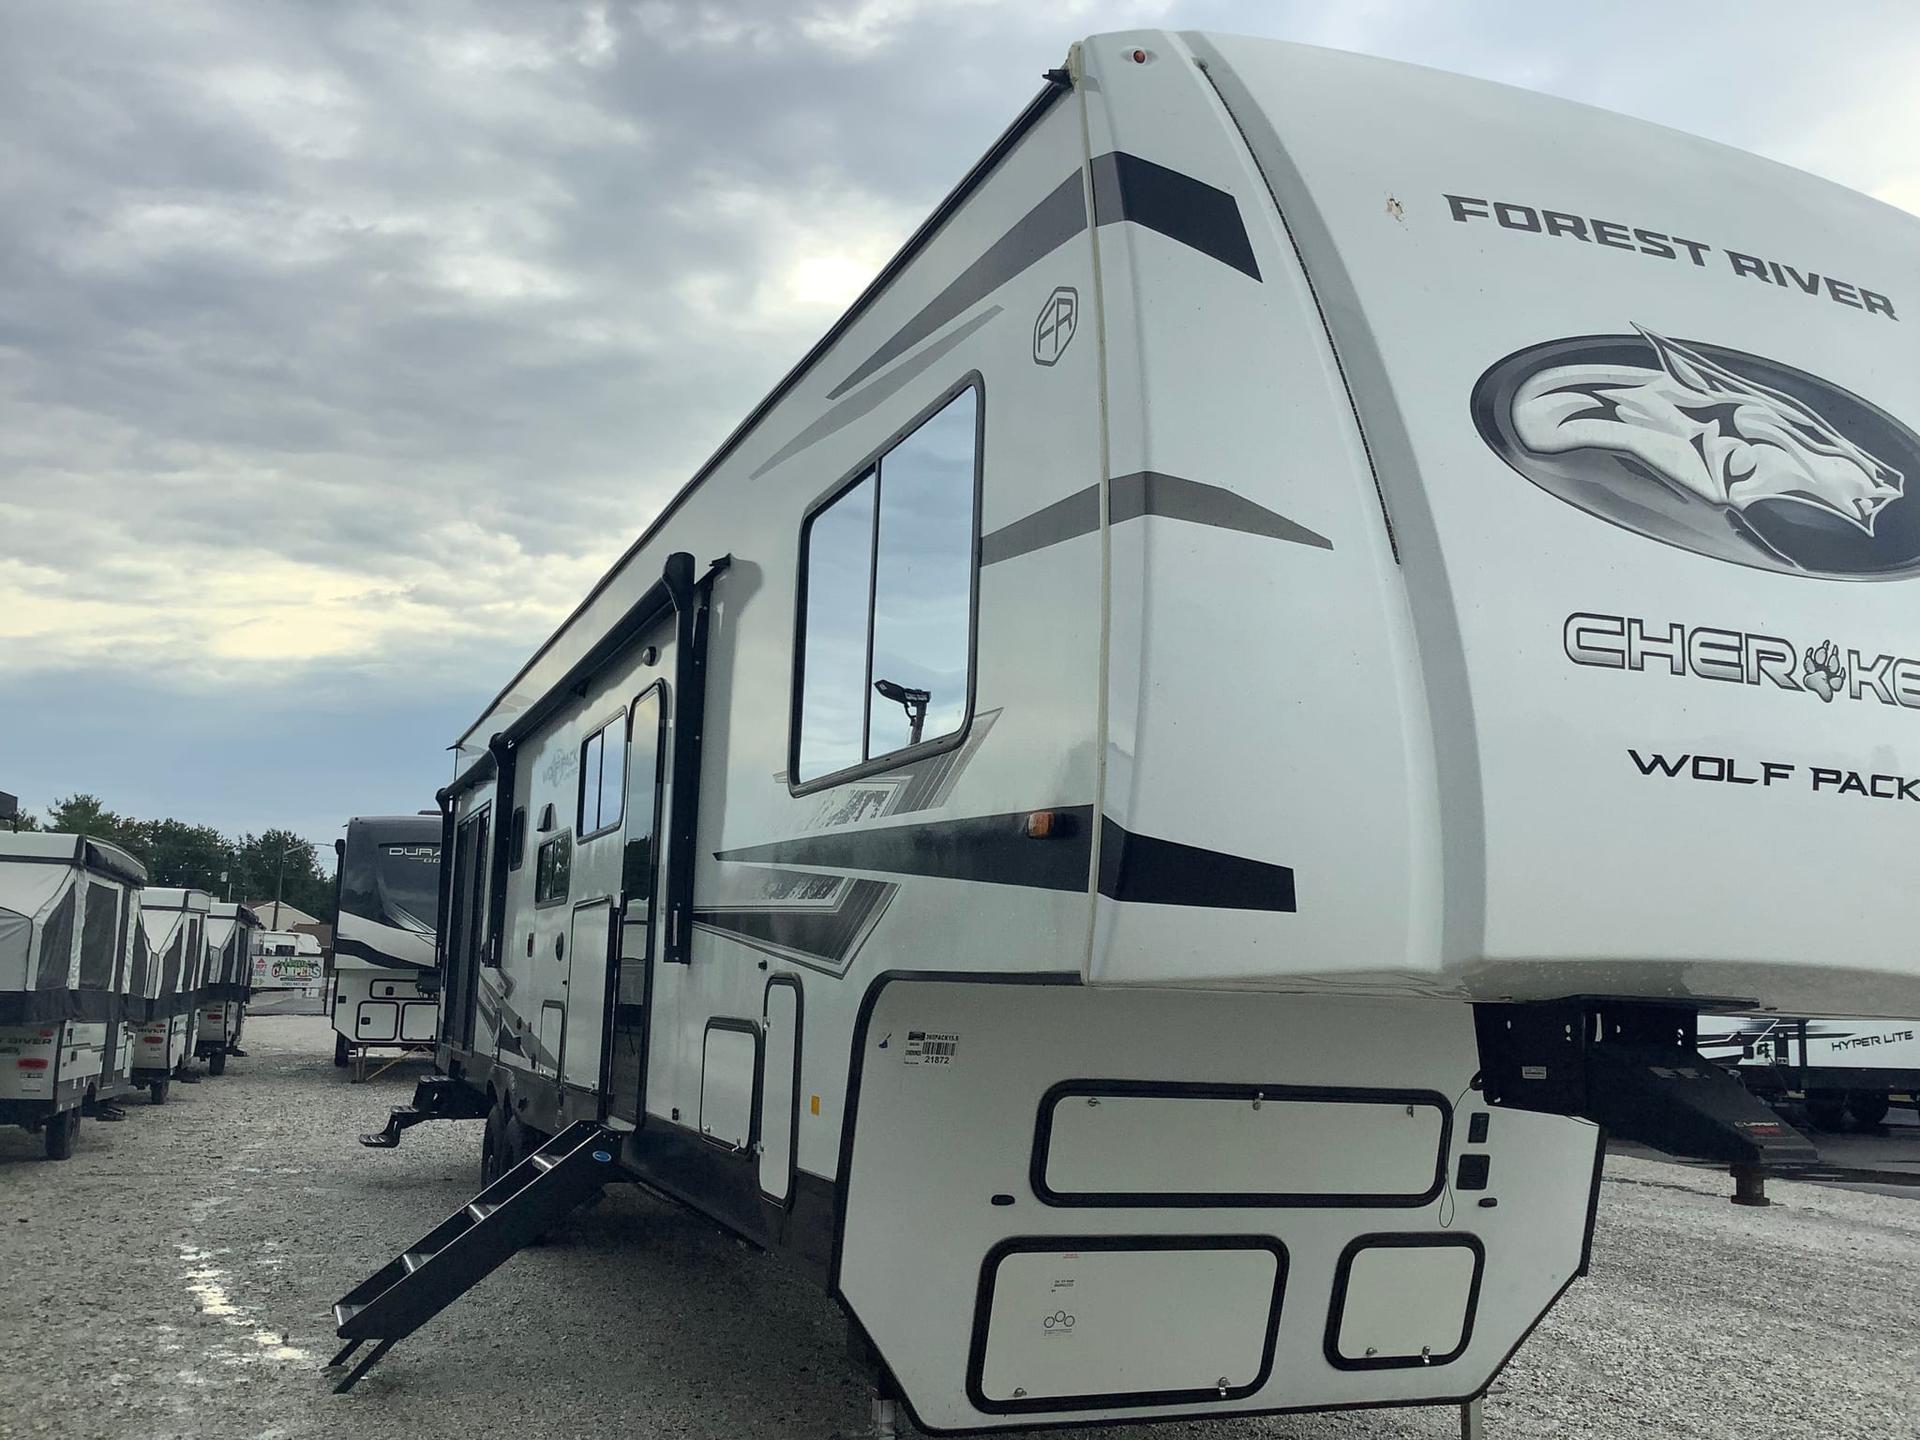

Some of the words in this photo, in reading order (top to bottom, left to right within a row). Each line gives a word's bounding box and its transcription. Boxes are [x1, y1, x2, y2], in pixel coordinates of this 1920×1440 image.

[1442, 193, 1711, 268] FOREST
[1723, 248, 1900, 322] RIVER
[1563, 611, 1920, 710] CHERKE
[1627, 749, 1796, 786] WOLF
[1808, 766, 1920, 802] PACK
[271, 965, 322, 979] CAMPERS
[1831, 1035, 1882, 1052] HYPER
[1883, 1030, 1915, 1044] LITE
[924, 1055, 950, 1065] 21872
